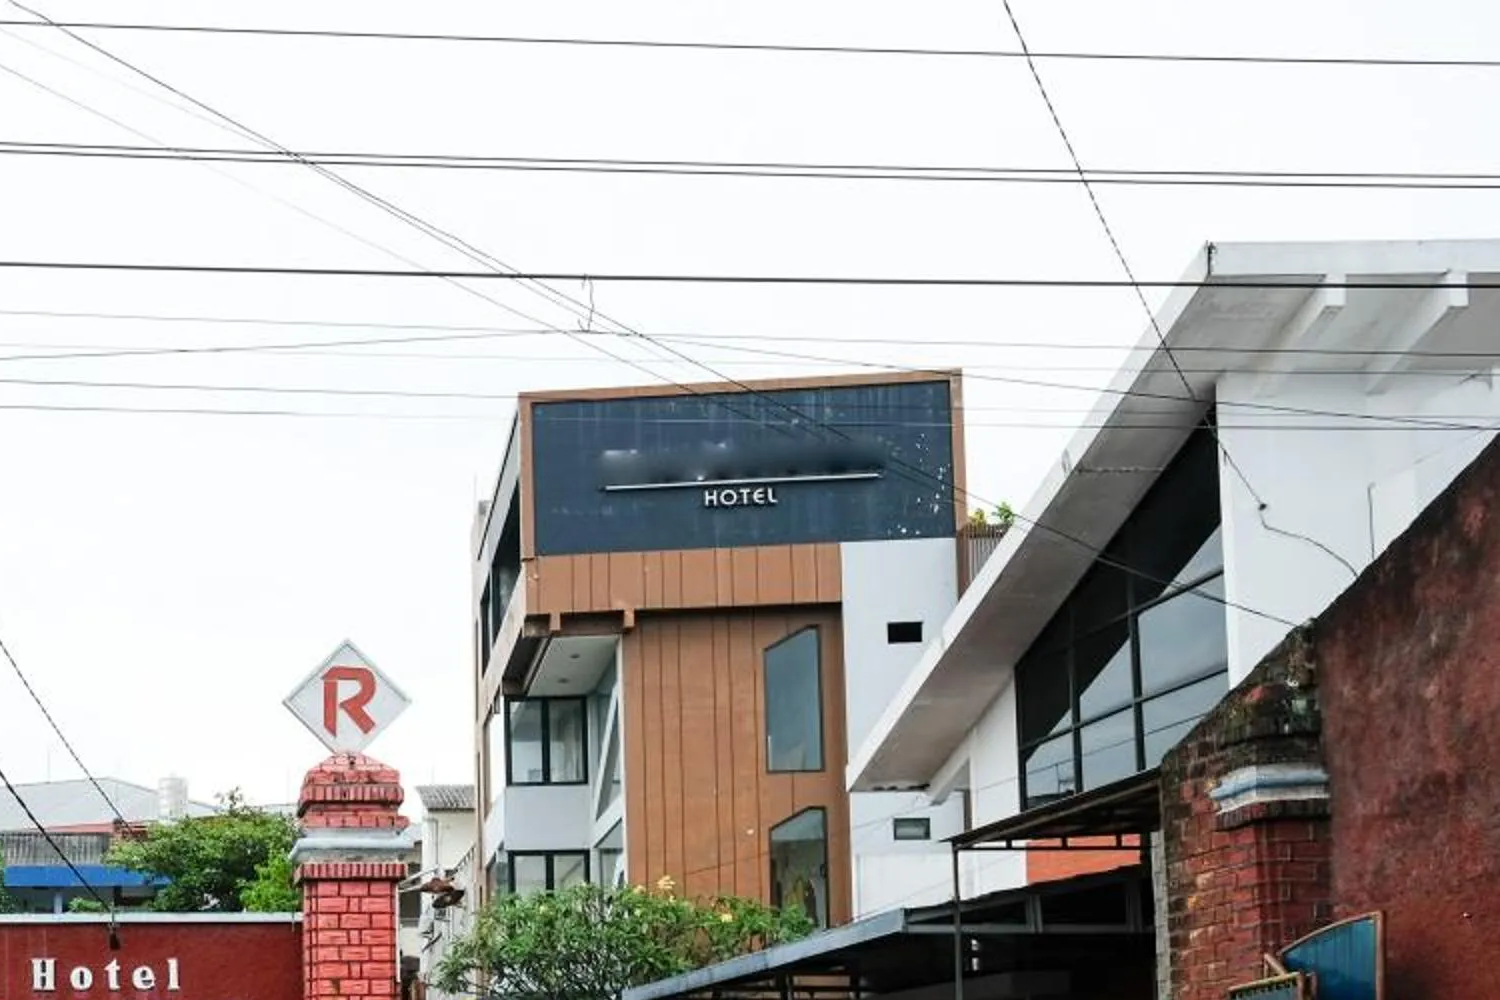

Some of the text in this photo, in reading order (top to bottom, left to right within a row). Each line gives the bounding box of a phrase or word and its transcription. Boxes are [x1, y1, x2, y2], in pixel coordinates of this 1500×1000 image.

[704, 487, 778, 507] HOTEL
[321, 665, 376, 738] R
[31, 957, 180, 991] Hotel
